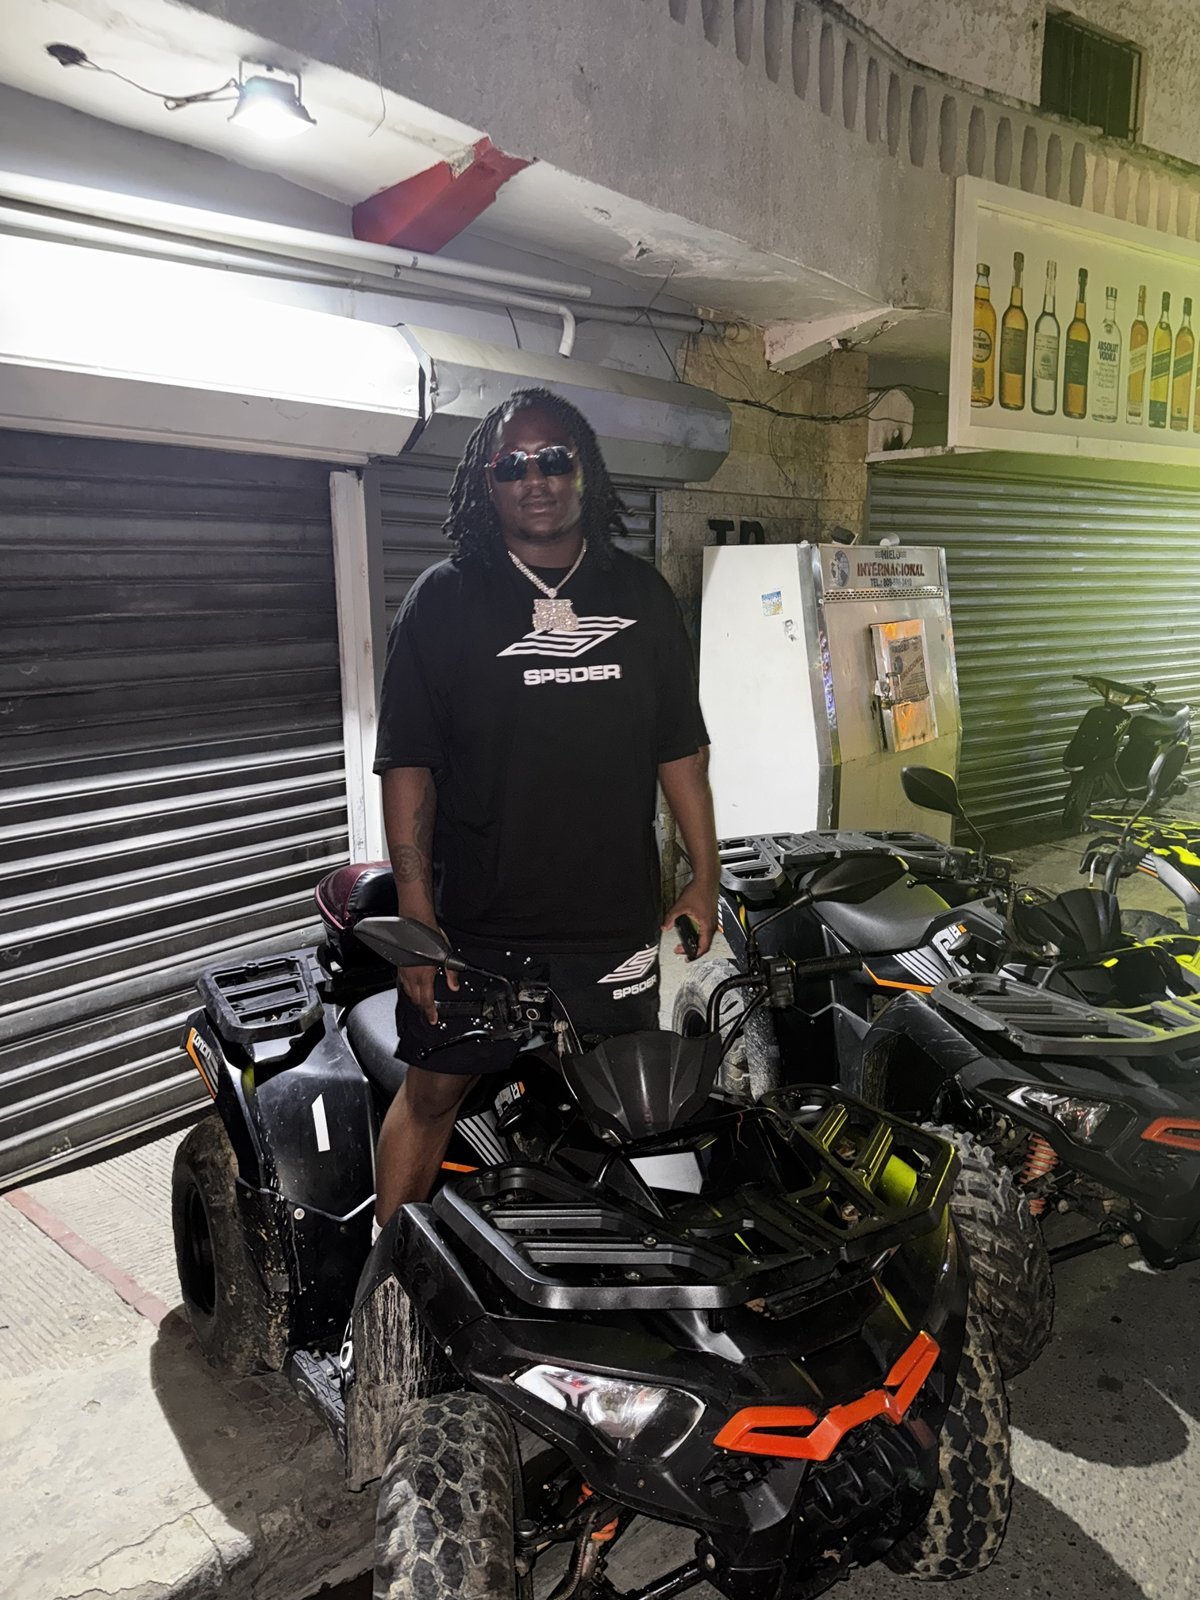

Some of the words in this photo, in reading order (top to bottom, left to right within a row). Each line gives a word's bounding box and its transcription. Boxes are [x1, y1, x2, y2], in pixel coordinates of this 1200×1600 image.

[1098, 341, 1119, 353] ABSOLUT
[1099, 351, 1117, 361] VODKA
[857, 561, 925, 577] INTERNACIONAL
[523, 664, 622, 686] SP5DER
